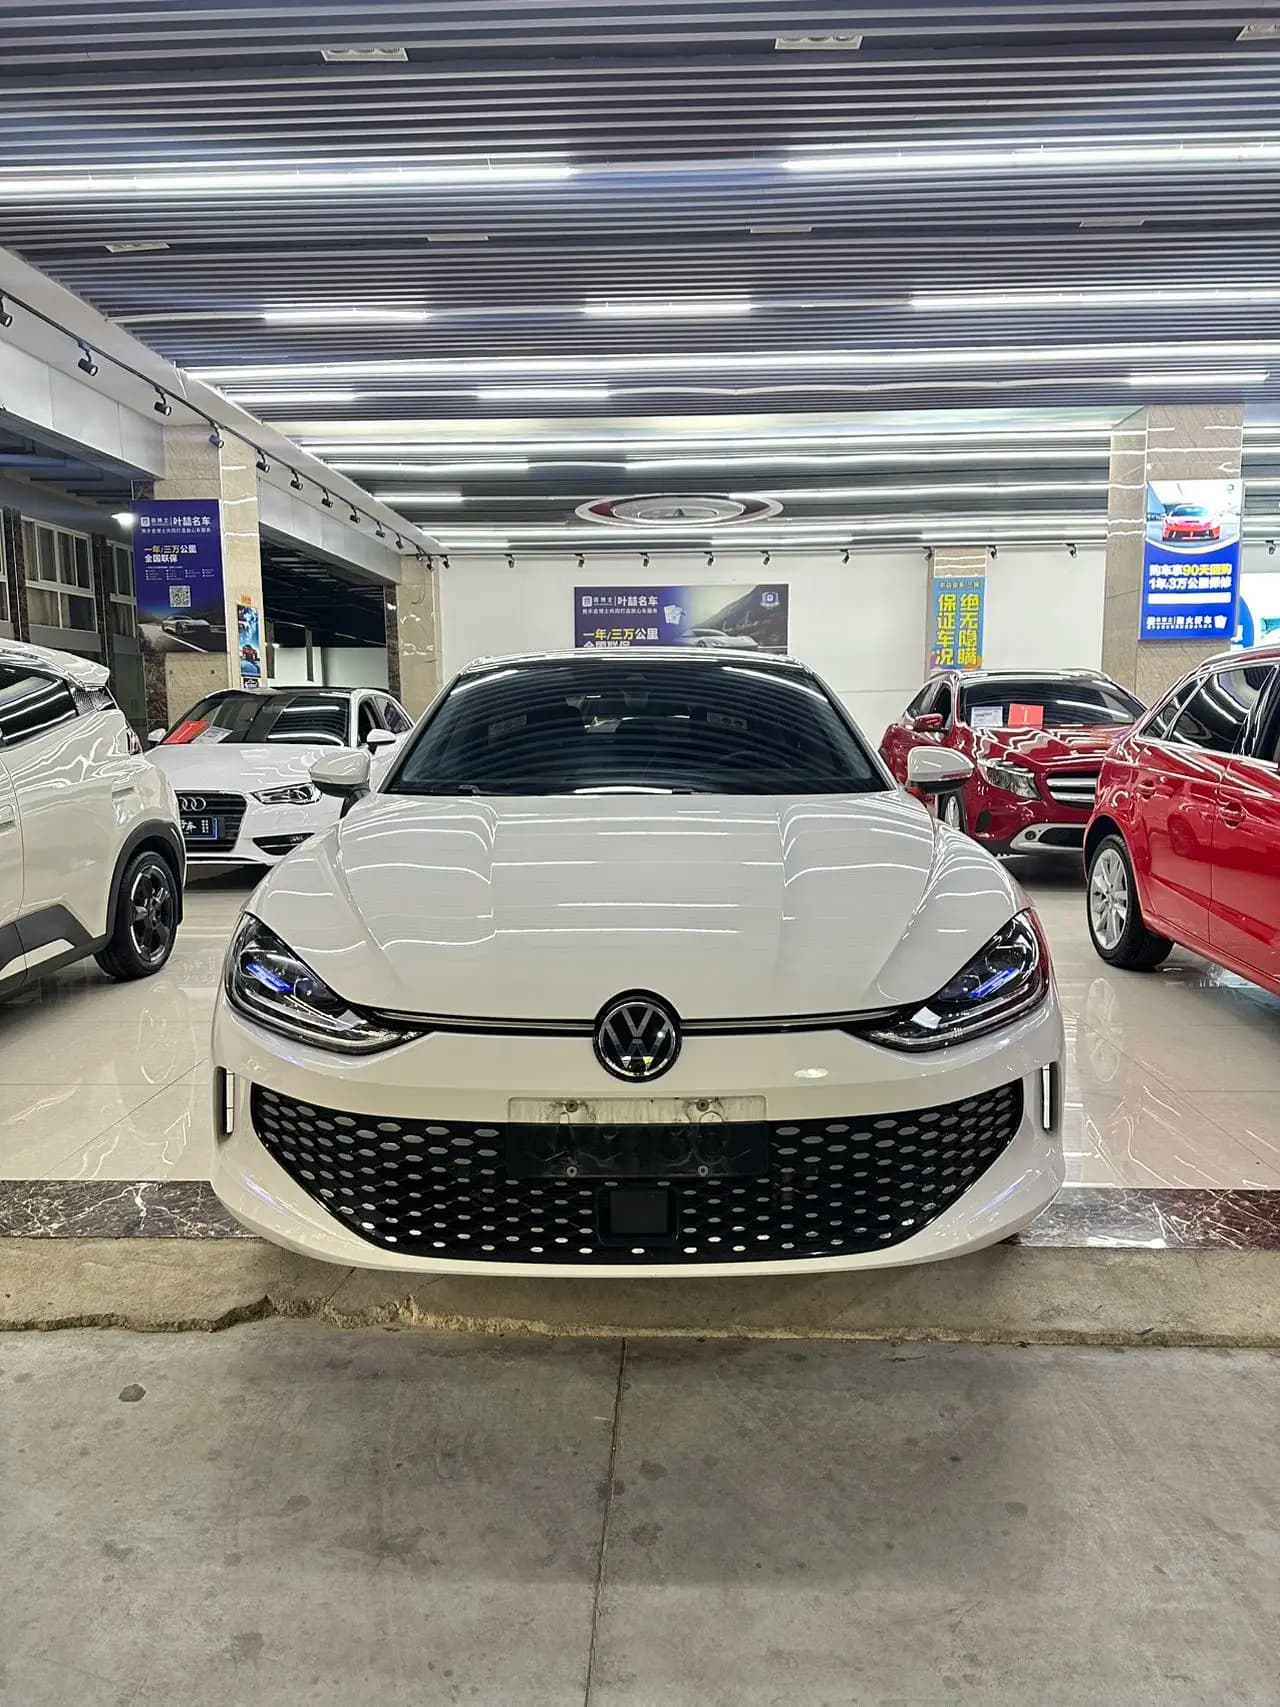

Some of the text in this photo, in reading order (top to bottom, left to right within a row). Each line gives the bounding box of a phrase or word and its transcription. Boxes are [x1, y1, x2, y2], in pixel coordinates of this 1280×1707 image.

[583, 627, 659, 640] 一年/三万公里
[934, 593, 957, 666] 保证车况
[958, 593, 980, 665] 绝无隐瞒
